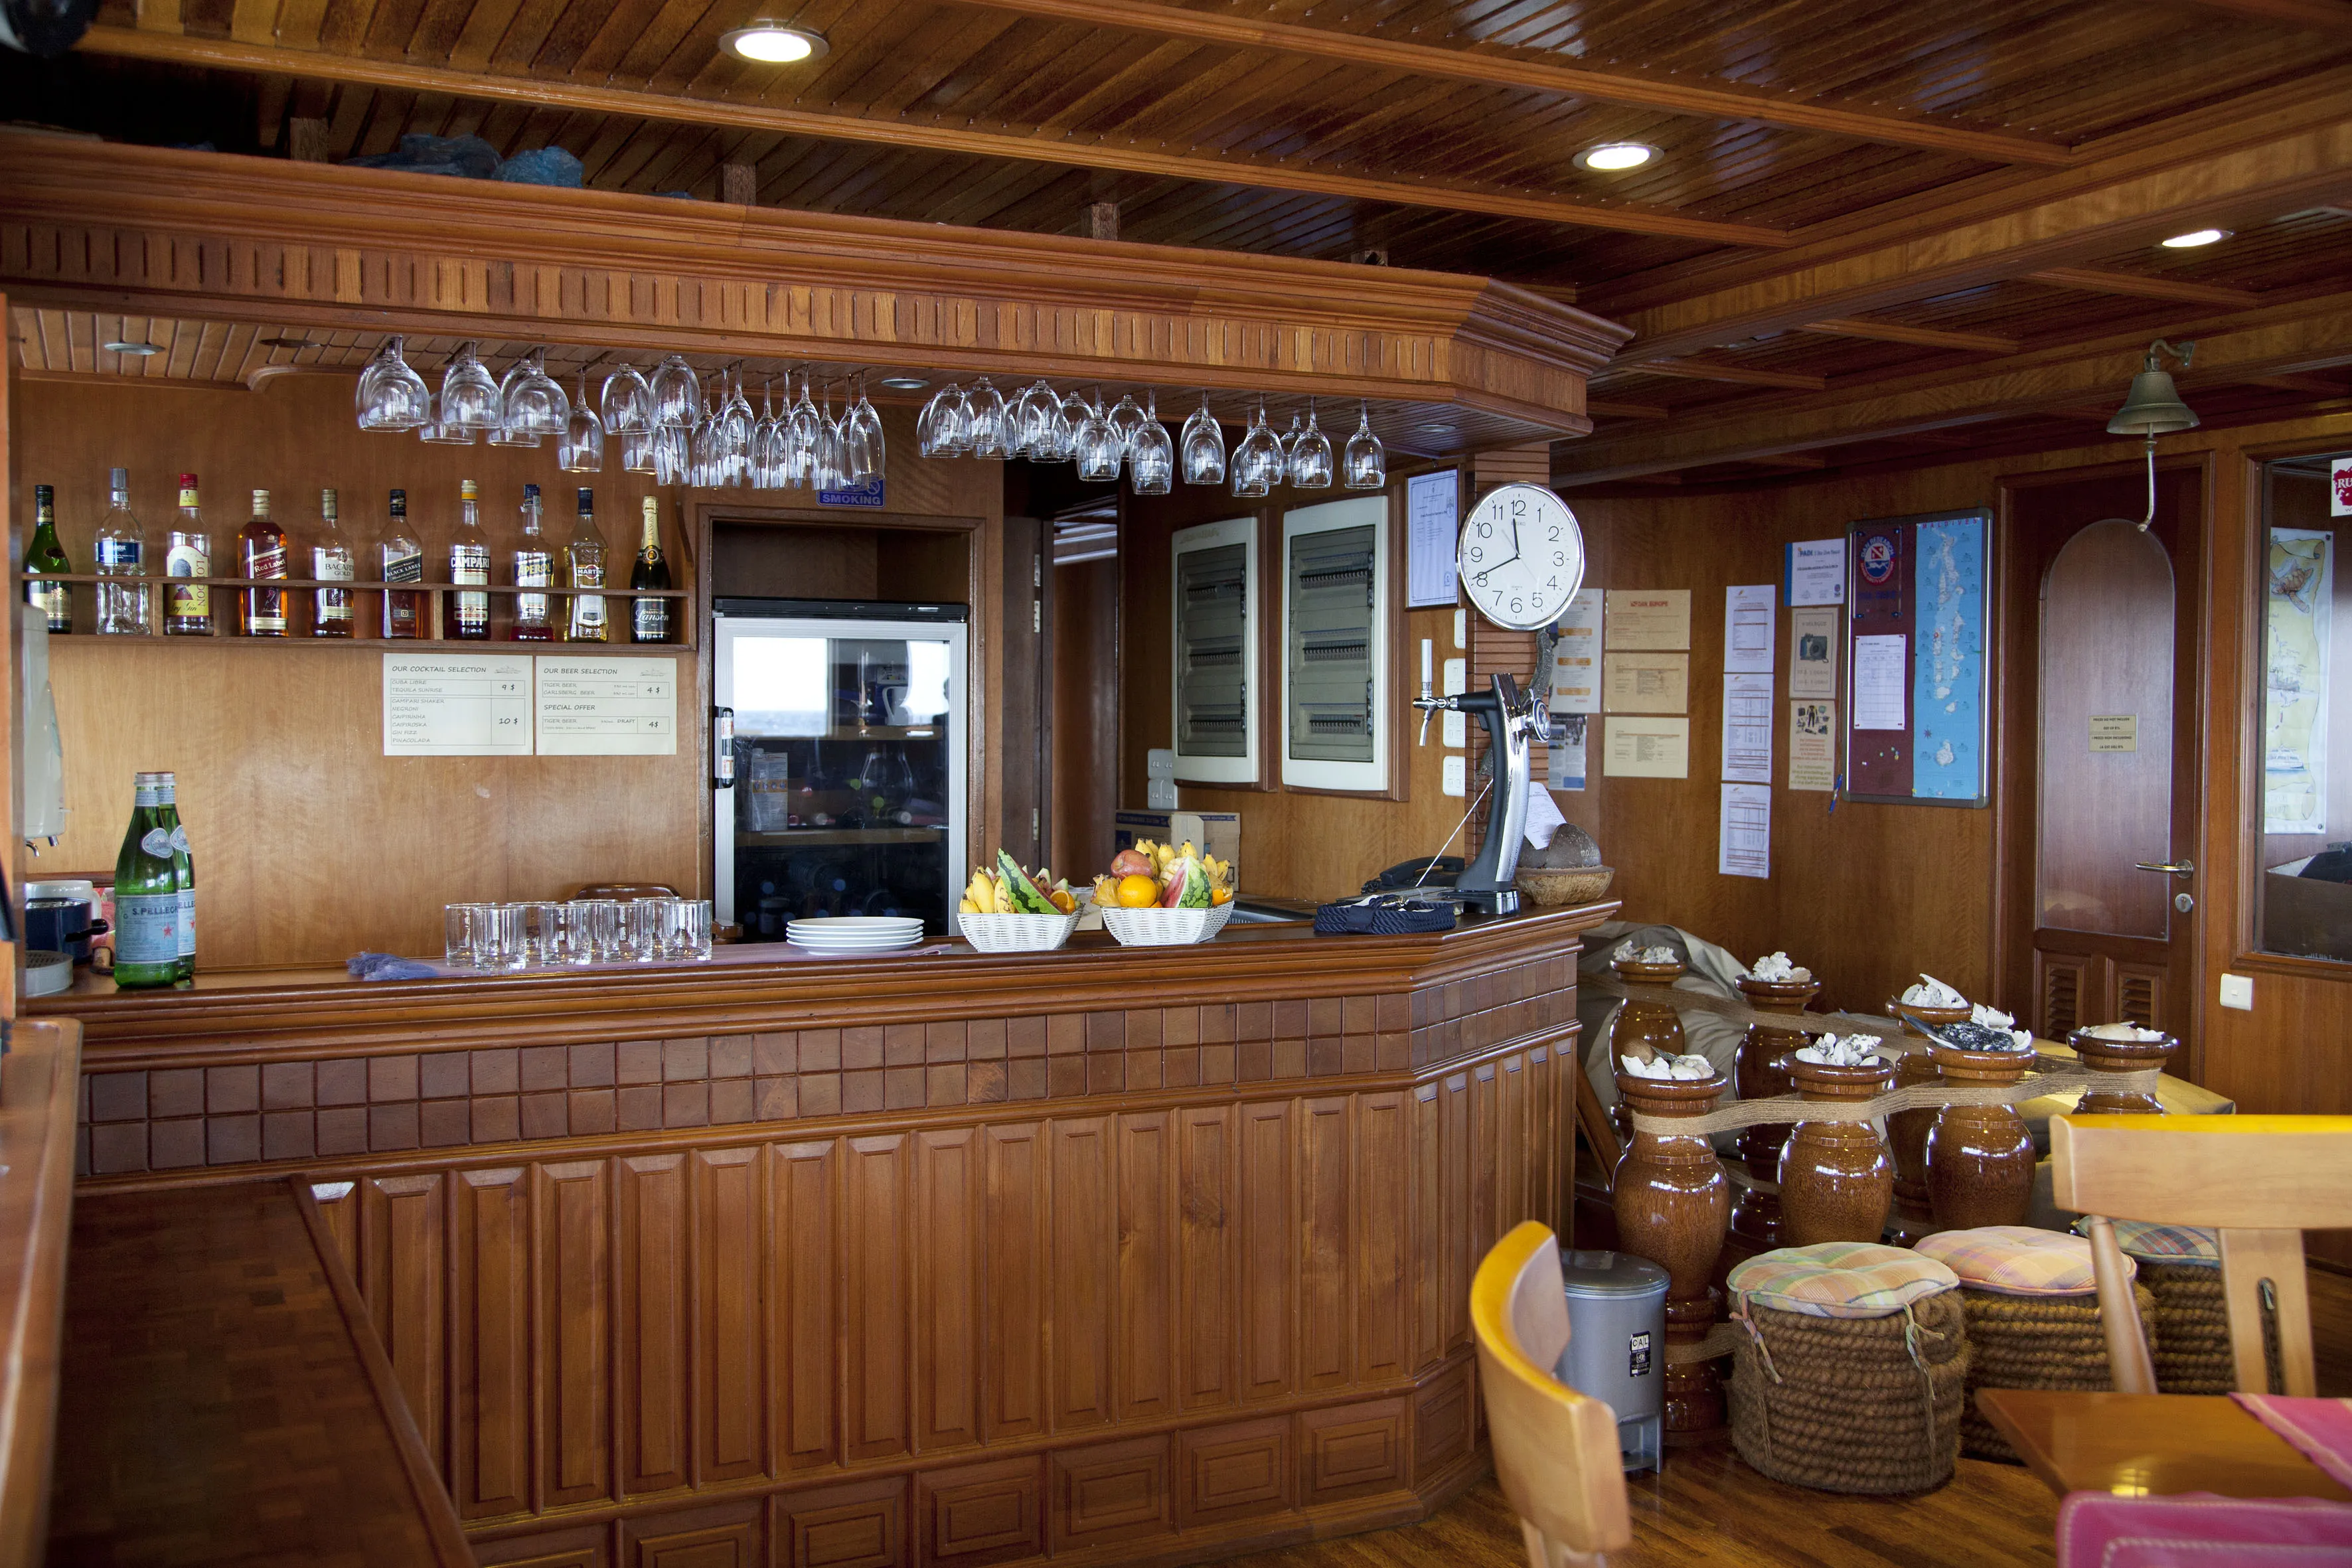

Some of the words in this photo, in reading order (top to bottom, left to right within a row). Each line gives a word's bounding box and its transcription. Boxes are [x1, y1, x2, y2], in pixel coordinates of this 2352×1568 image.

[823, 494, 880, 505] SMOKING
[1492, 504, 1503, 520] 11
[1511, 500, 1526, 516] 12
[1537, 507, 1541, 522] 1
[1476, 522, 1492, 538] 10
[1548, 526, 1559, 541] 2
[451, 556, 489, 568] CAMPARI
[1470, 547, 1482, 562] 9
[1553, 551, 1564, 566] 3
[269, 559, 285, 568] Label
[518, 564, 550, 576] APEROL
[387, 568, 404, 577] BLACK
[1476, 572, 1488, 587] 8
[196, 560, 205, 605] LODON
[1547, 576, 1558, 590] 4
[1492, 590, 1503, 605] 7
[1510, 597, 1522, 613] 6
[1532, 593, 1543, 607] 5
[635, 609, 669, 623] Lanson
[1633, 1338, 1648, 1347] CAL
